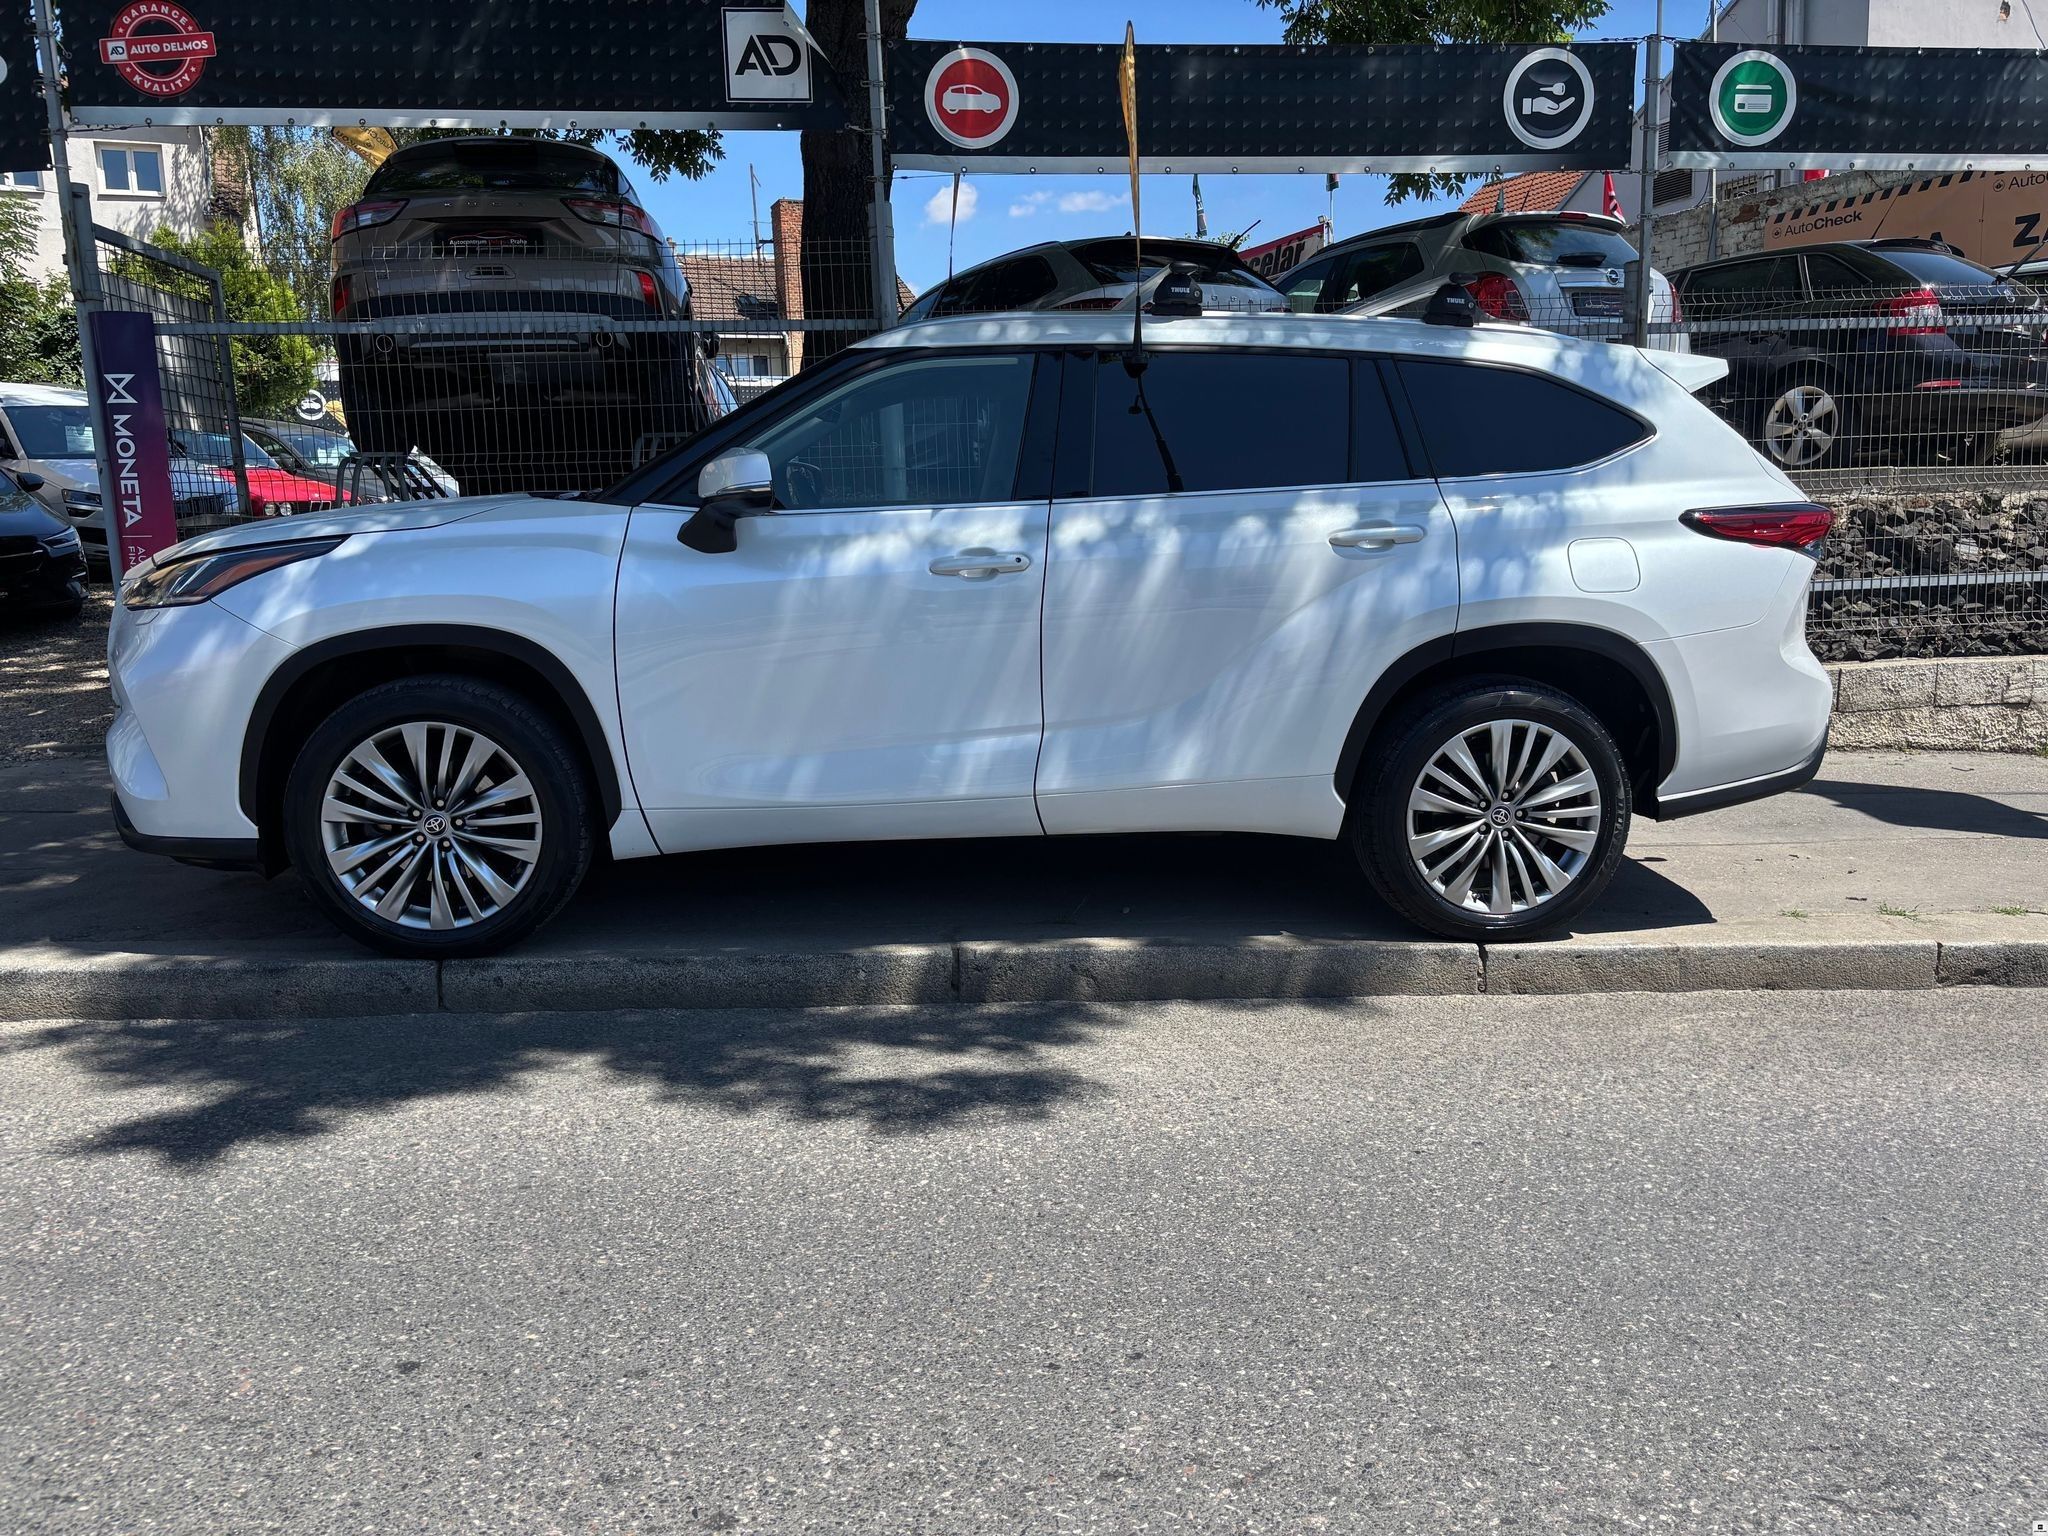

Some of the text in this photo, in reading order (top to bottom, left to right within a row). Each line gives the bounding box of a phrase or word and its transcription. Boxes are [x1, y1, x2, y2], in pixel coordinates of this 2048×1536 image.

[122, 4, 188, 25] GARANCE
[130, 43, 161, 55] AUTO
[163, 39, 209, 53] DELMOS
[734, 34, 802, 76] AD
[132, 72, 191, 92] KVALITY
[1783, 210, 1863, 237] AutoCheck
[1171, 286, 1190, 294] THULE
[1446, 297, 1465, 305] THULE
[113, 414, 143, 529] MONETA
[127, 545, 137, 569] FIN
